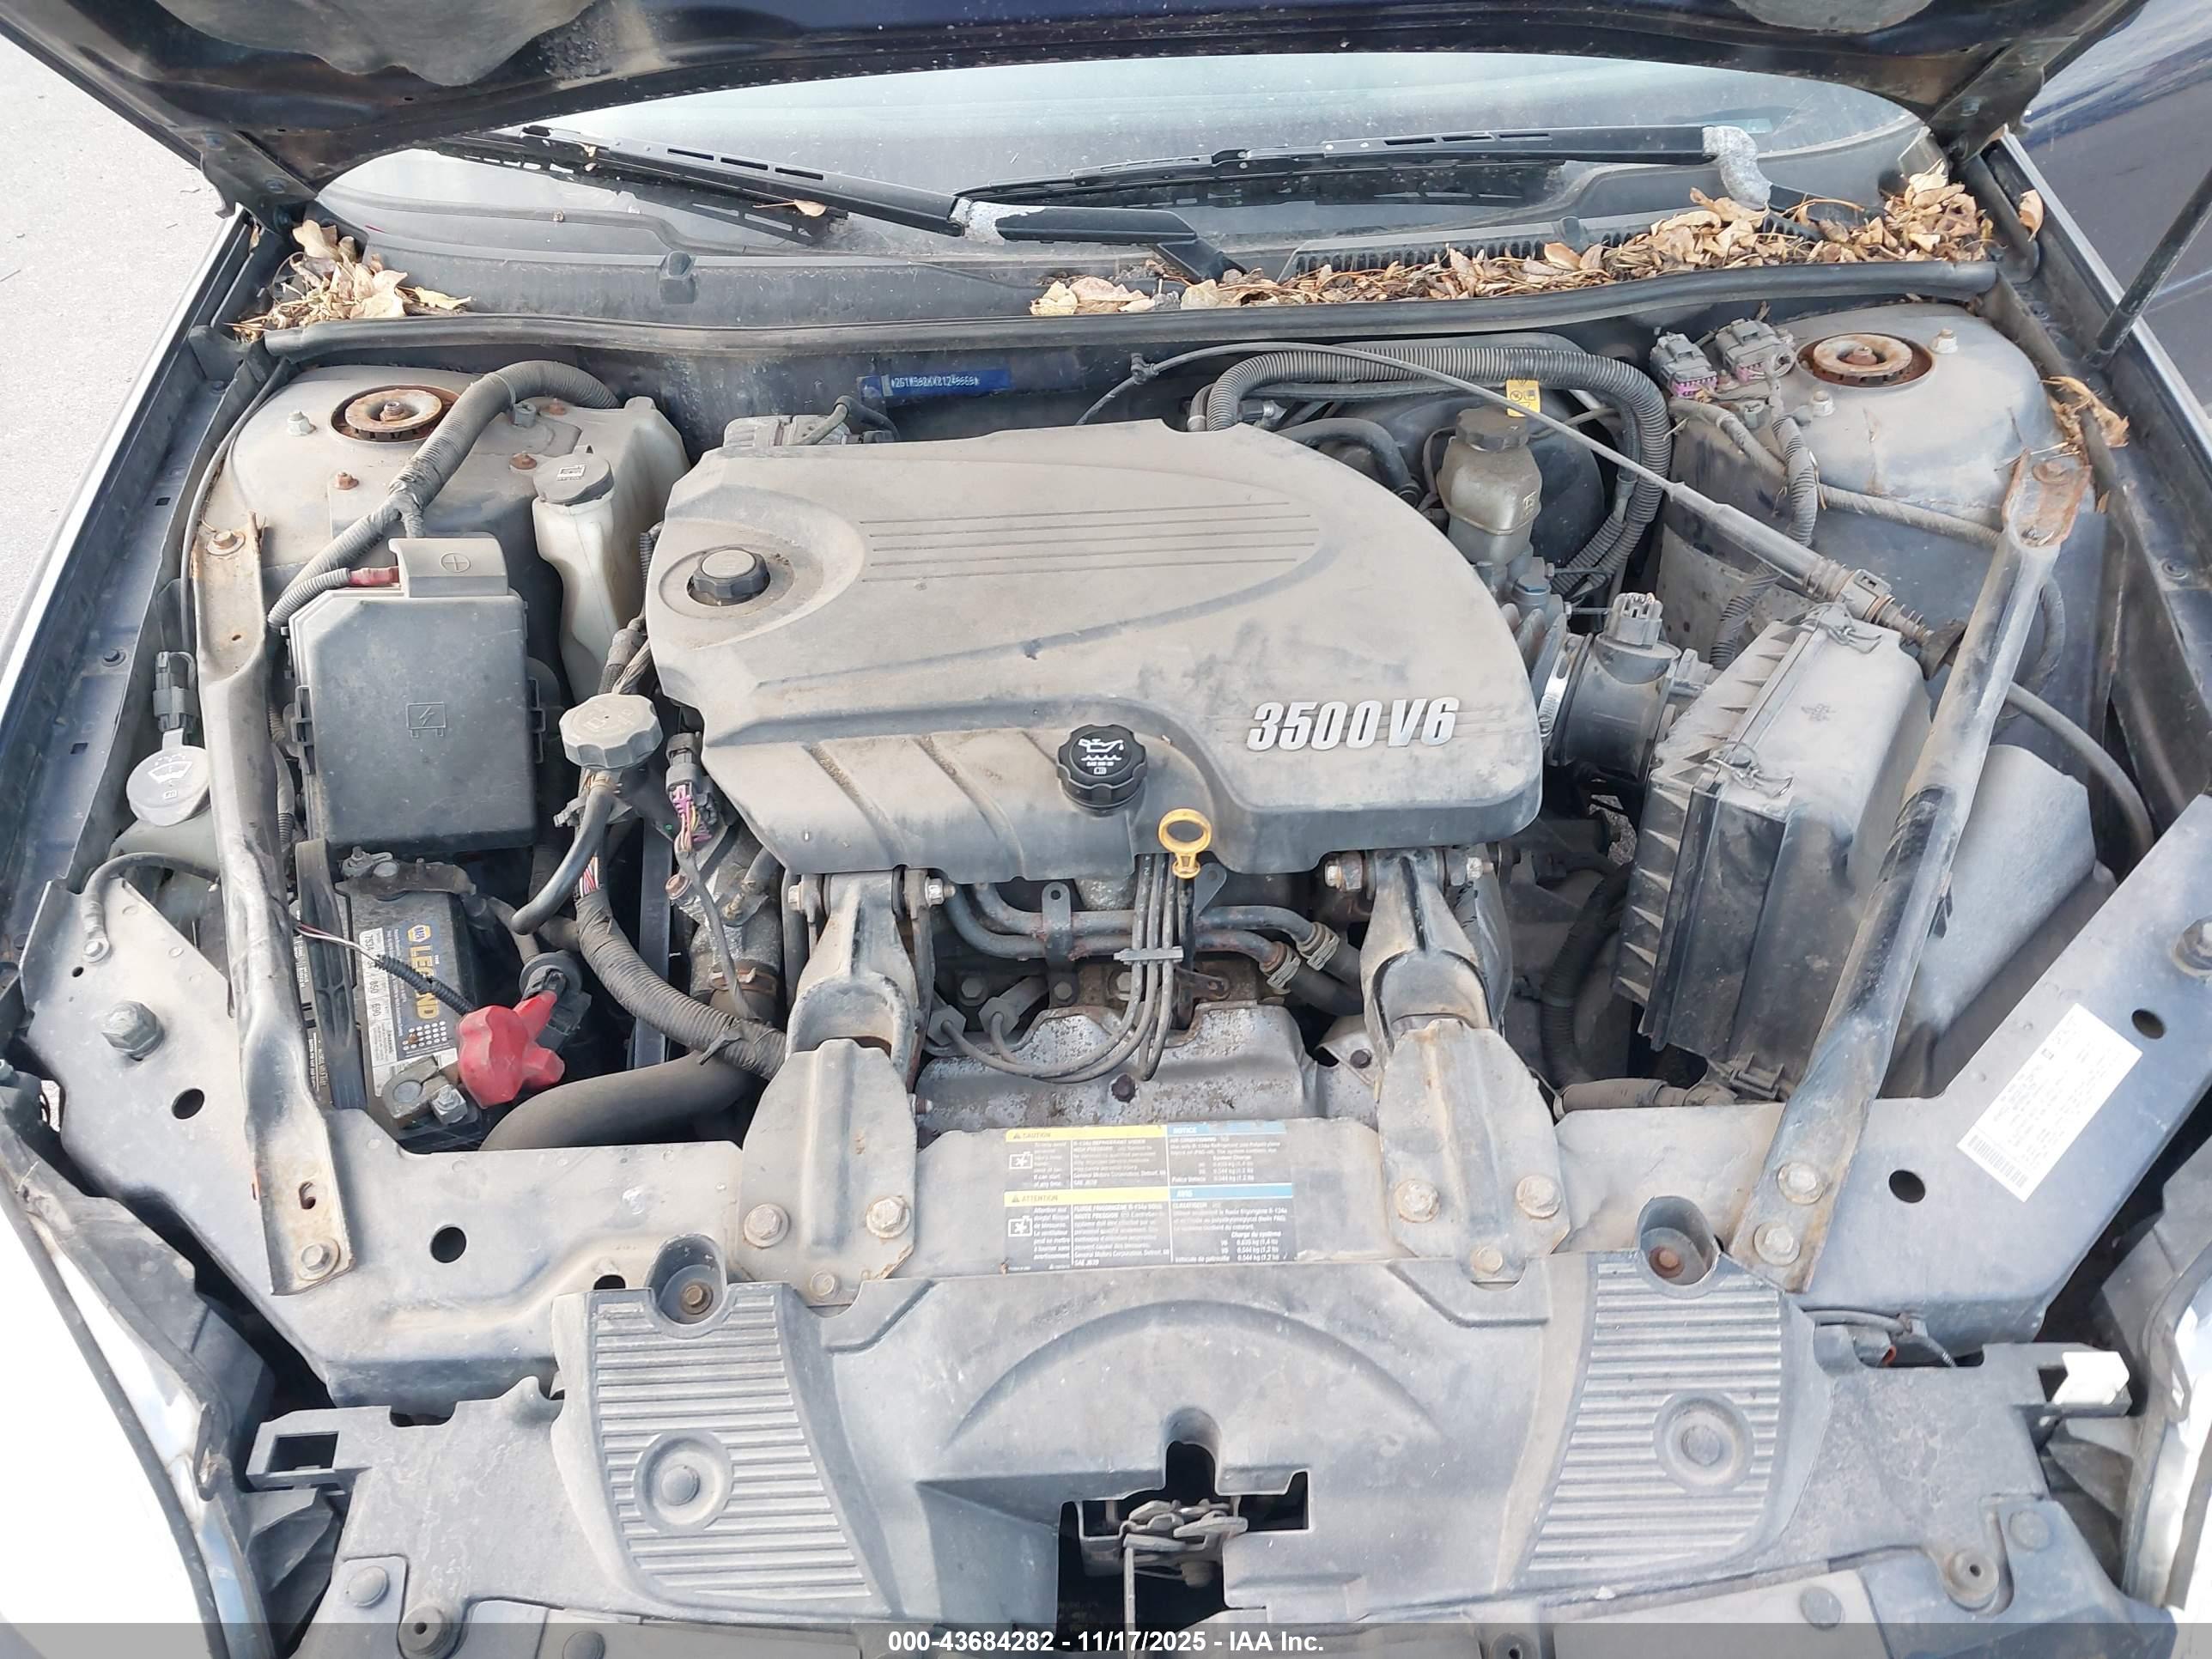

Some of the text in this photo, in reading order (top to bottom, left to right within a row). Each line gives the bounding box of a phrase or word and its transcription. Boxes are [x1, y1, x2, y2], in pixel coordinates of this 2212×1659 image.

[1247, 696, 1460, 751] 3500 V6
[369, 981, 379, 994] 850
[410, 945, 440, 1019] LEGND
[371, 1003, 381, 1017] 690
